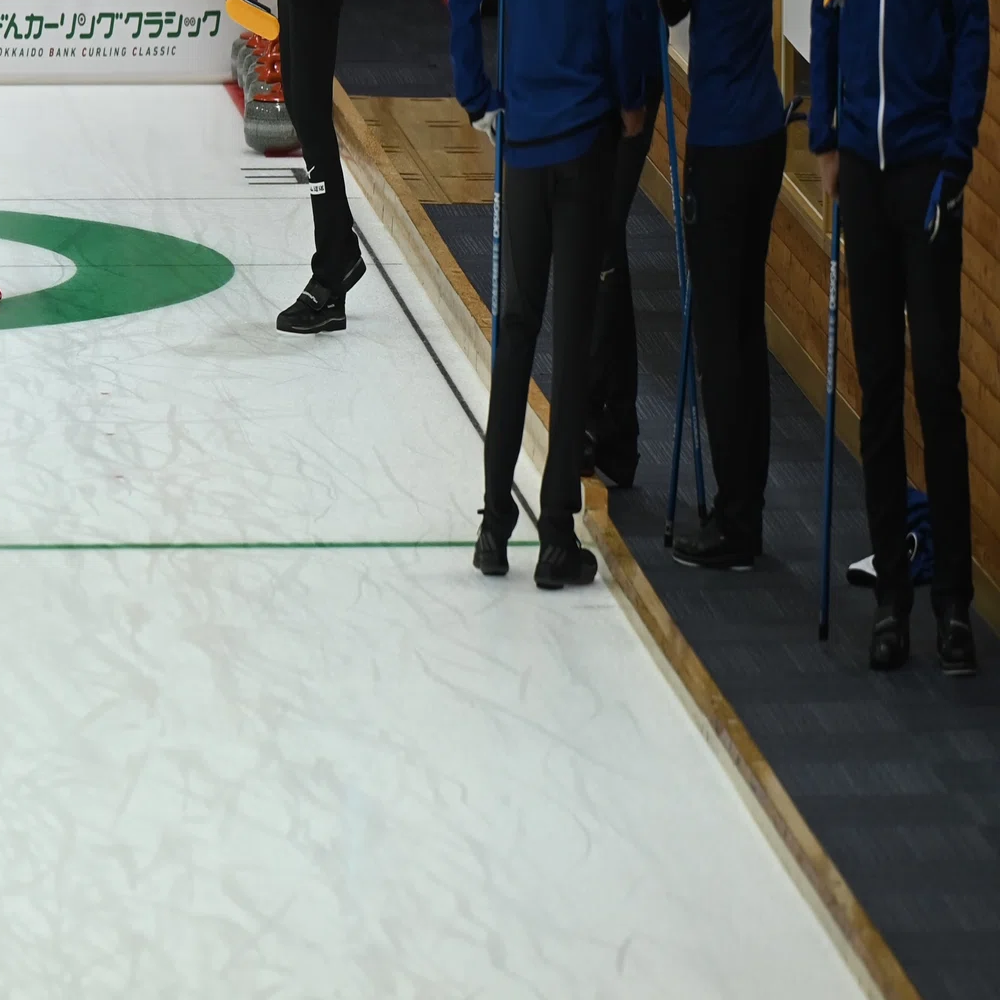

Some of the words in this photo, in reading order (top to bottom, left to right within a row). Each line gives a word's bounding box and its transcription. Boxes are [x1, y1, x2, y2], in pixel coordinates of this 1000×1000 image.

[49, 47, 77, 57] BANK
[81, 46, 127, 57] CURLING
[132, 46, 177, 56] CLASSIC
